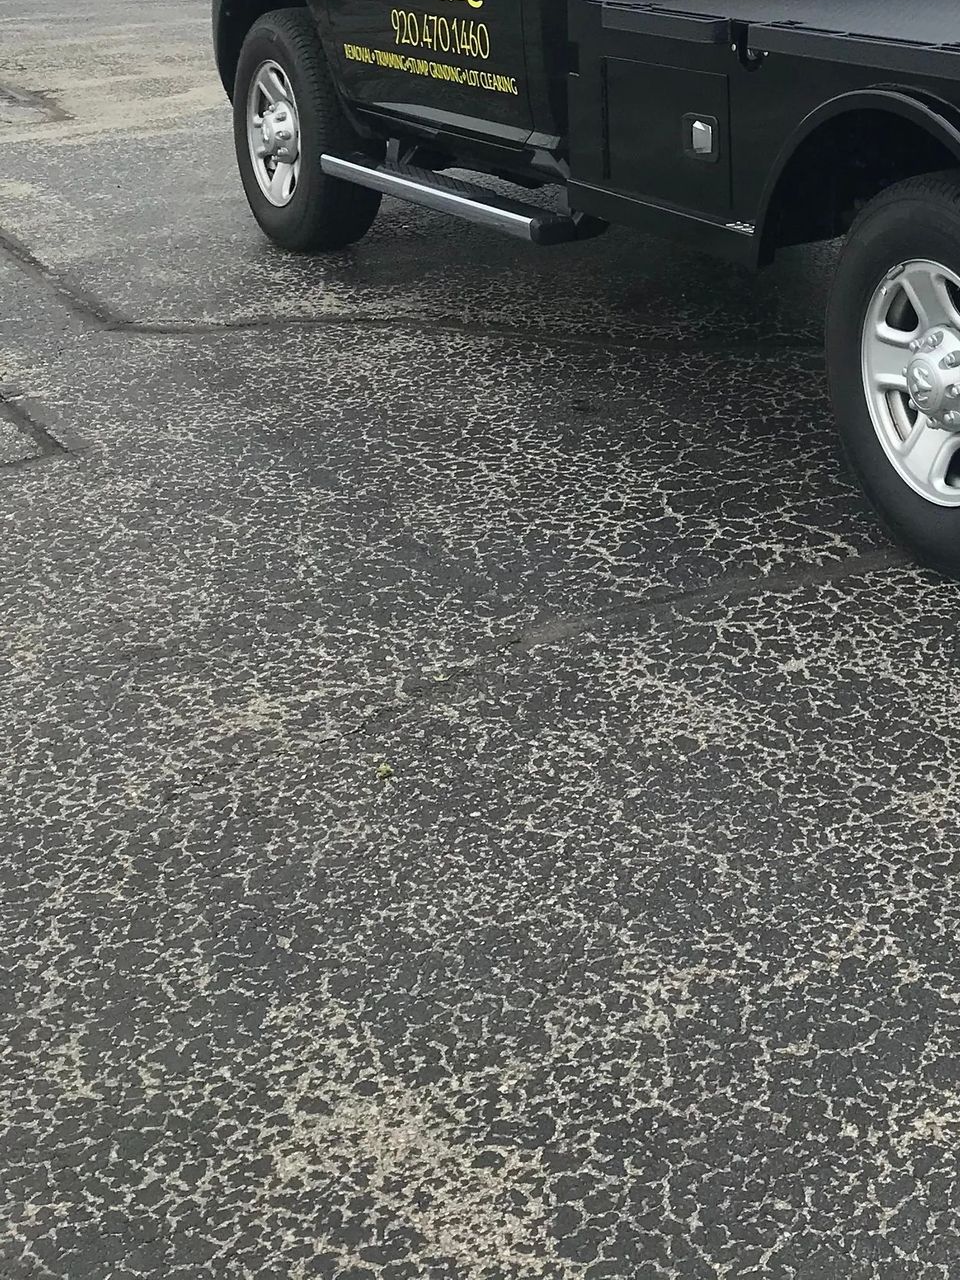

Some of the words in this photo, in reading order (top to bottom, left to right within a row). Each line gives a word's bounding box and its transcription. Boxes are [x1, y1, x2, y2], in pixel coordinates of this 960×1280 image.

[390, 8, 491, 60] 920.470.1460
[343, 43, 374, 64] REMOVAL
[373, 49, 408, 72] TRIMMING
[428, 61, 464, 84] GRINDING
[465, 68, 481, 87] LOT
[479, 71, 519, 96] CLEARING
